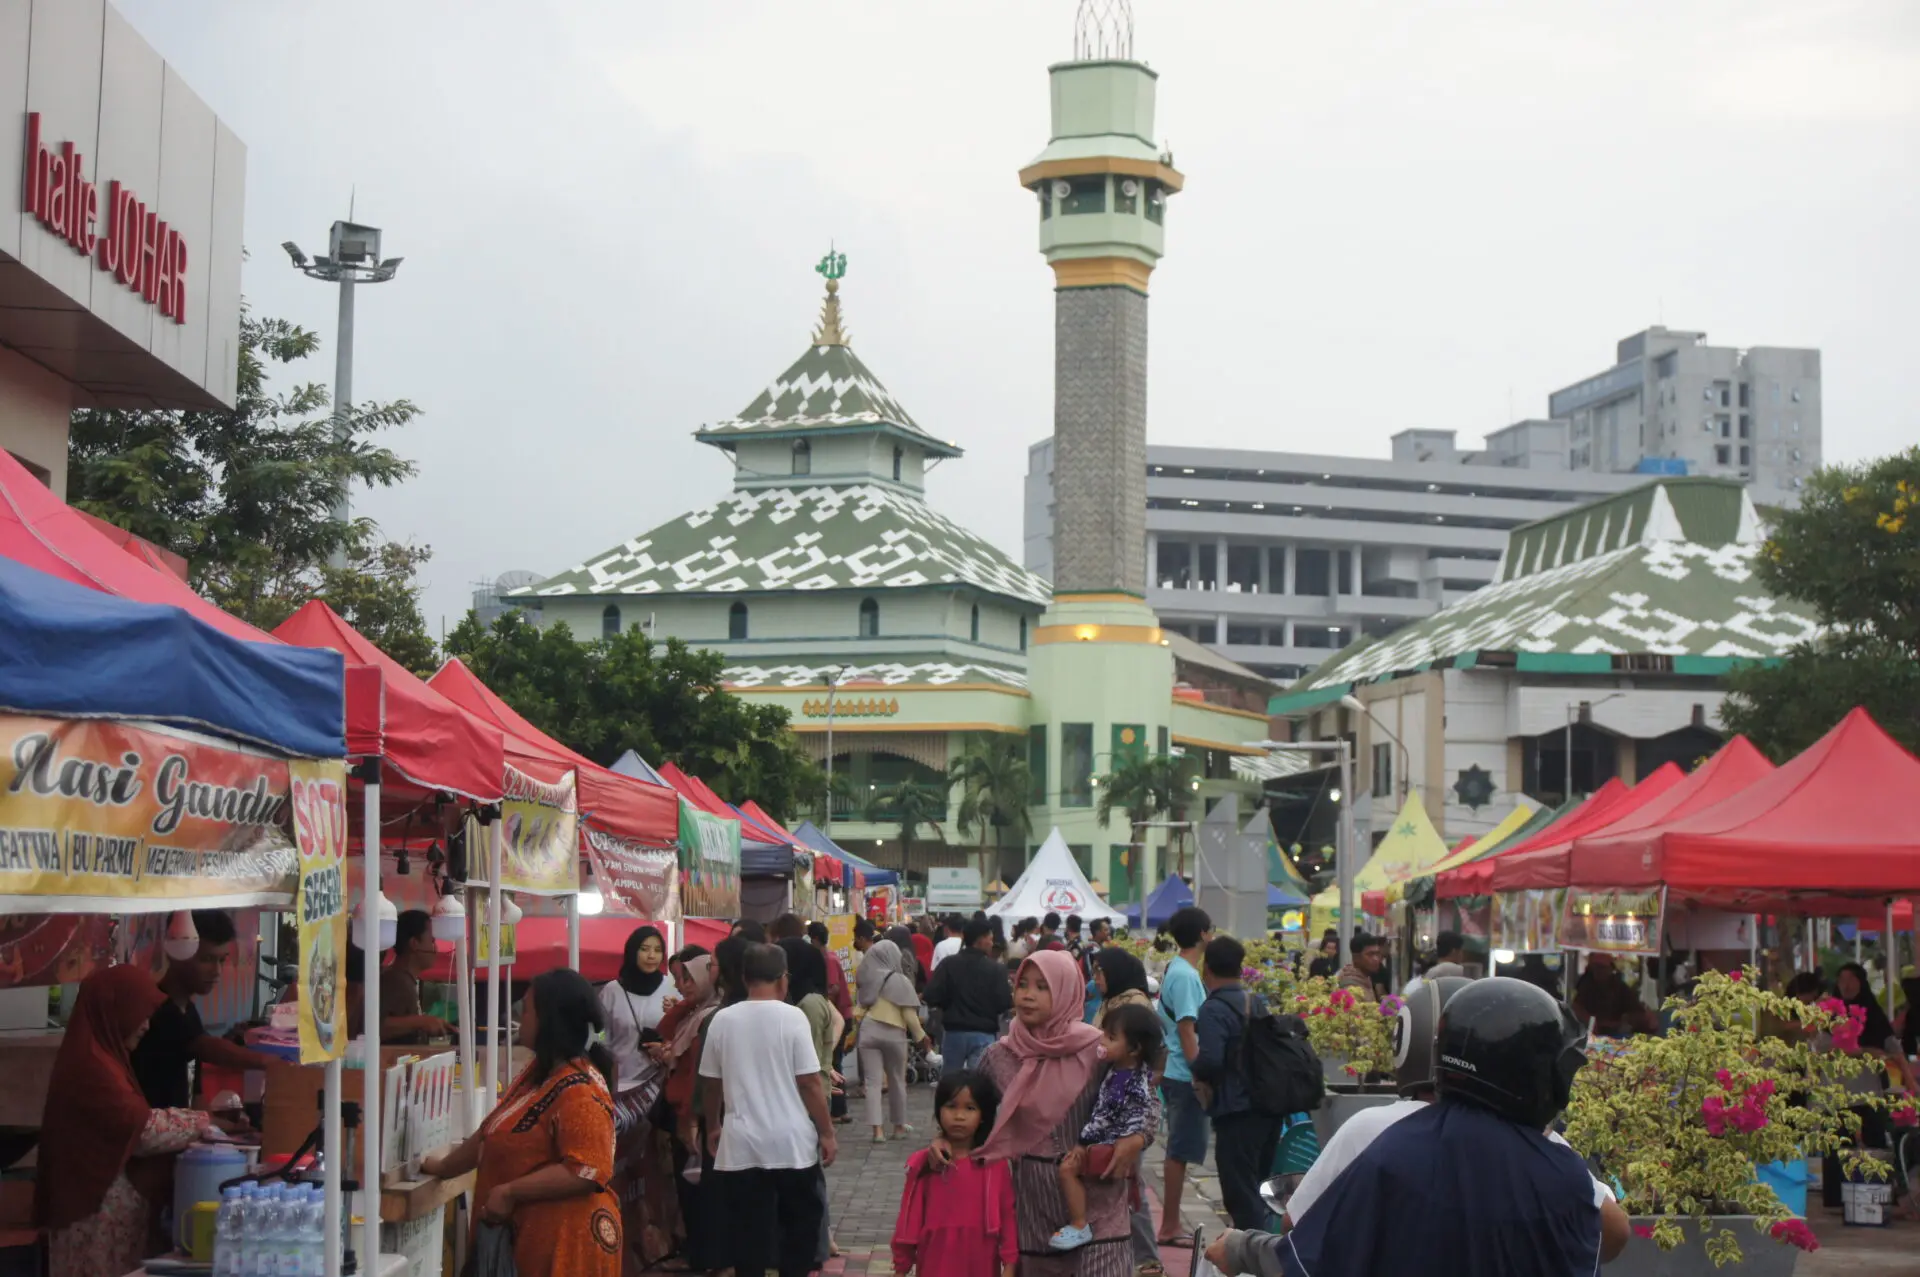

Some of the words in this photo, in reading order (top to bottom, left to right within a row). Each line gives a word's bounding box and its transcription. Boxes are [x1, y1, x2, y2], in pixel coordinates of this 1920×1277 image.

[25, 110, 97, 257] halte
[98, 179, 188, 325] JOHAR
[9, 733, 143, 805] Nasi
[1441, 1054, 1477, 1072] HONDA
